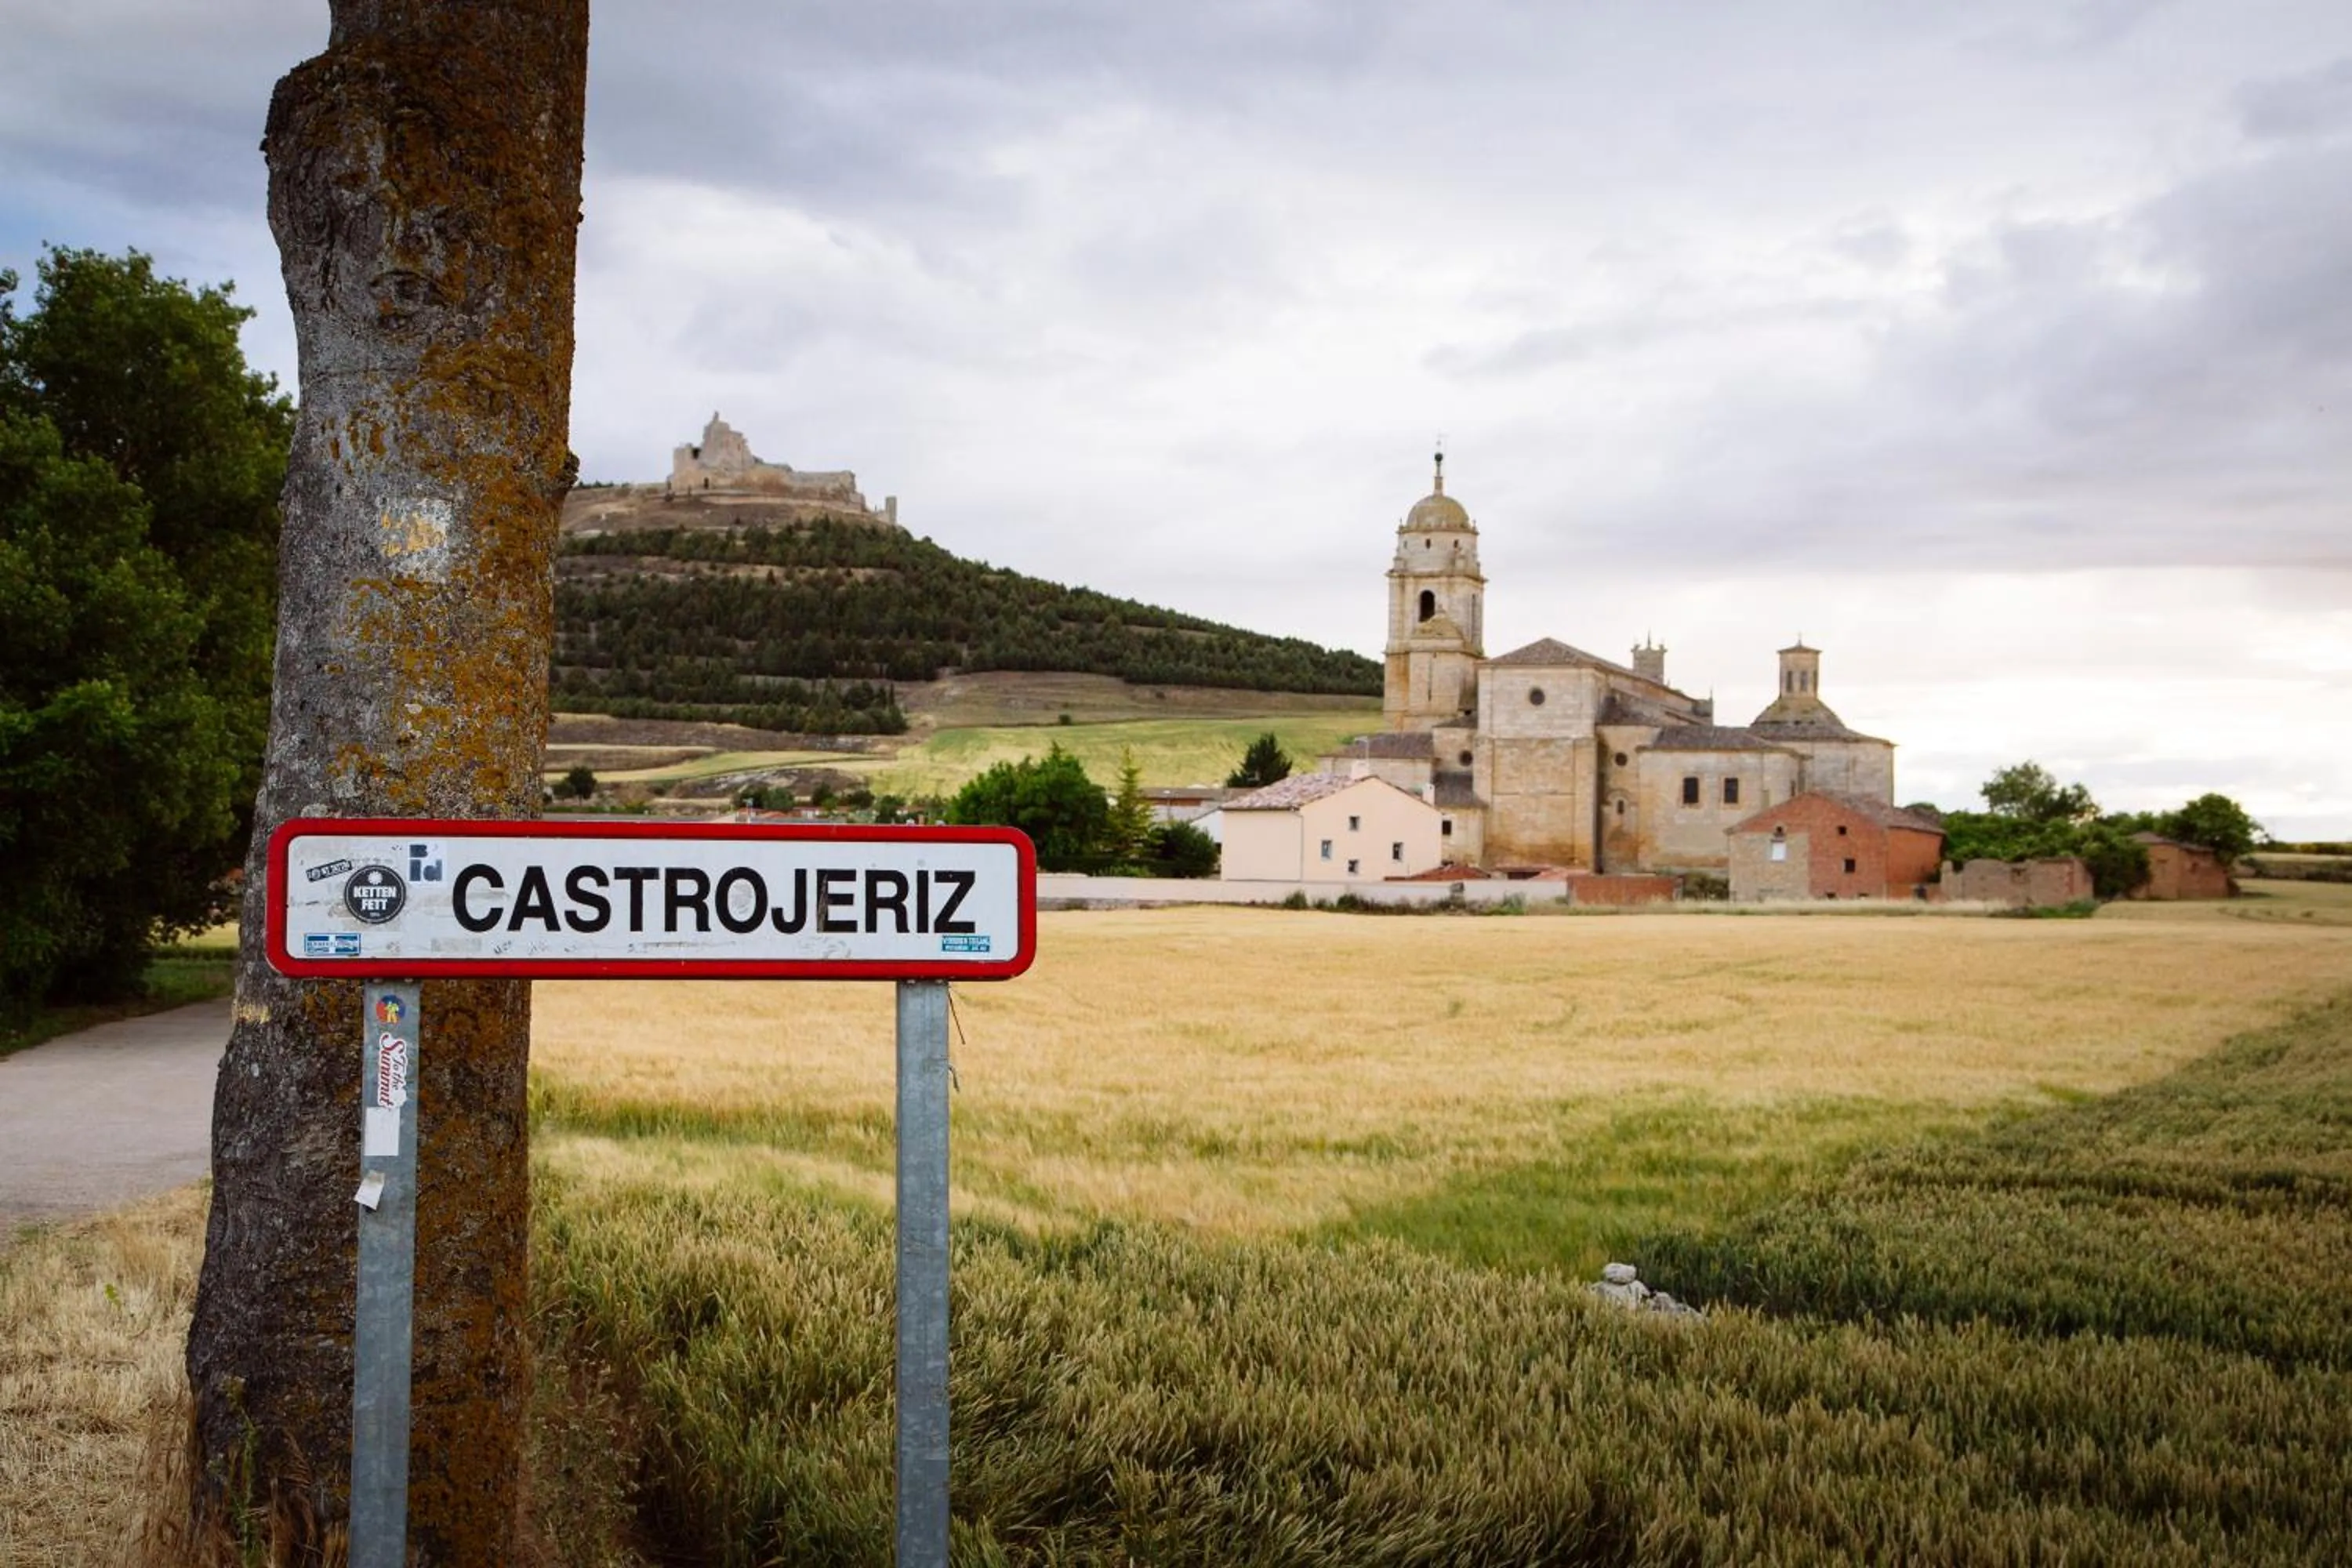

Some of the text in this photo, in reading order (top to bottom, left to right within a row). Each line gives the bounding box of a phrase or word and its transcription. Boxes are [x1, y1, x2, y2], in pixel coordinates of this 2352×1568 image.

[353, 886, 397, 898] KETTEN
[452, 863, 975, 935] CASTROJERIZ
[361, 898, 388, 910] FETT
[379, 1034, 405, 1106] Summit
[392, 1073, 405, 1091] the
